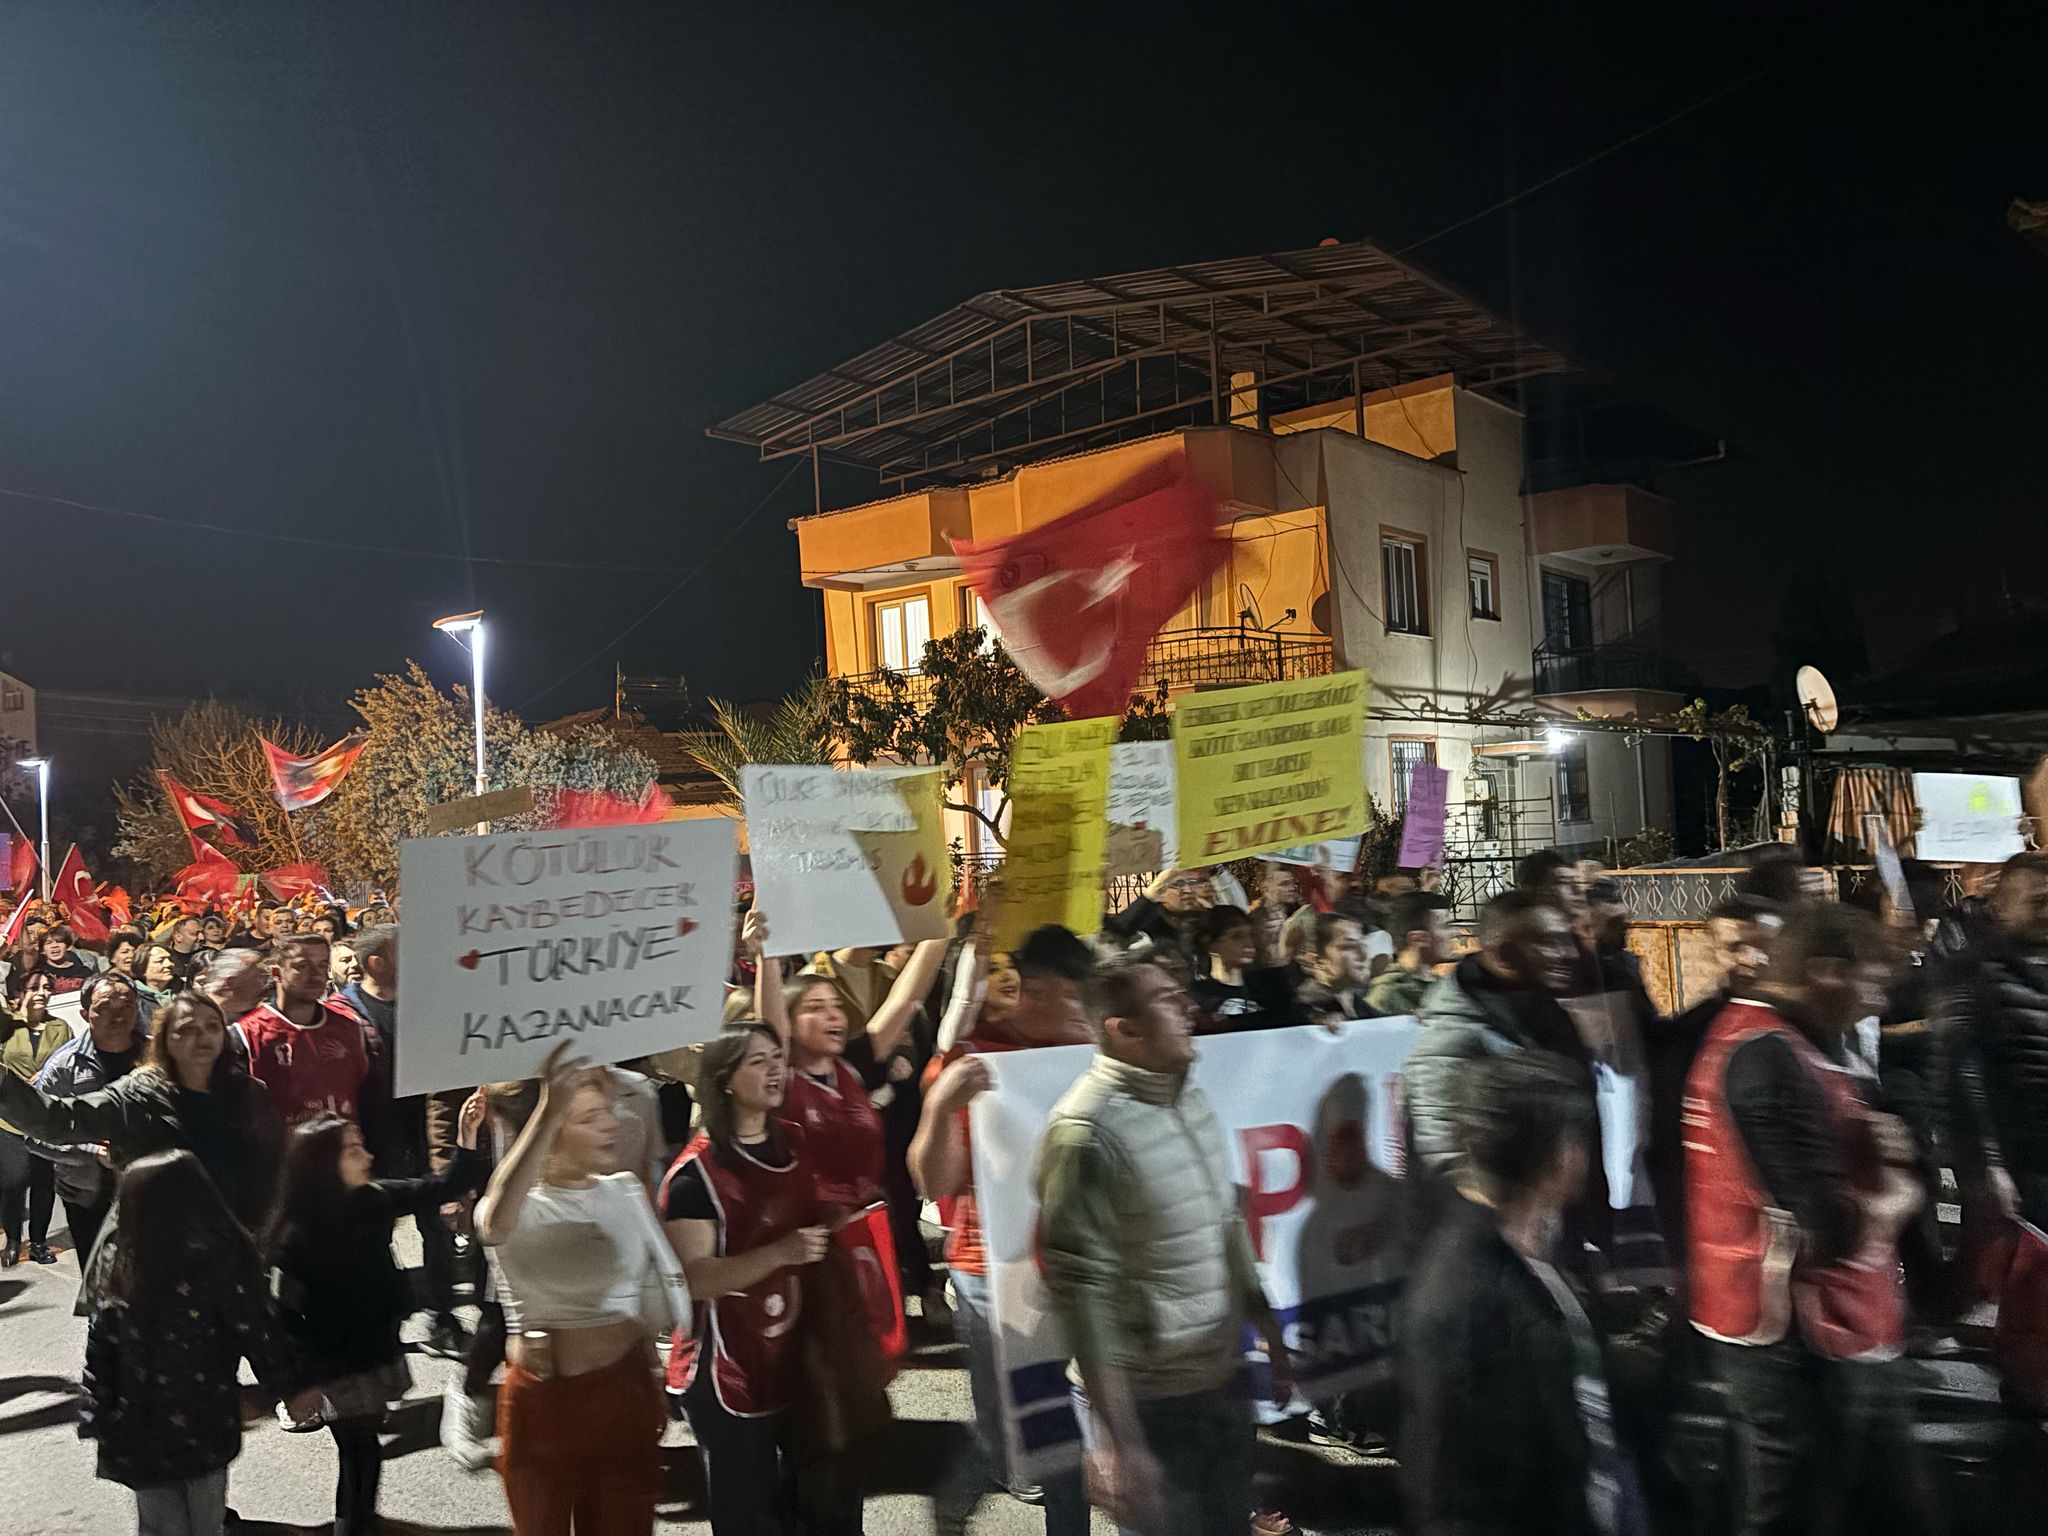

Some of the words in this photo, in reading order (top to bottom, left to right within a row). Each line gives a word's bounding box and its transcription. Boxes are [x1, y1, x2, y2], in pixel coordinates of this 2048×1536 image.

[464, 834, 680, 888] KÖTÜLÜK
[456, 882, 699, 937] KAYBEDECEK
[477, 924, 682, 986] TÜRKİYE
[458, 985, 696, 1056] KAZANACAK
